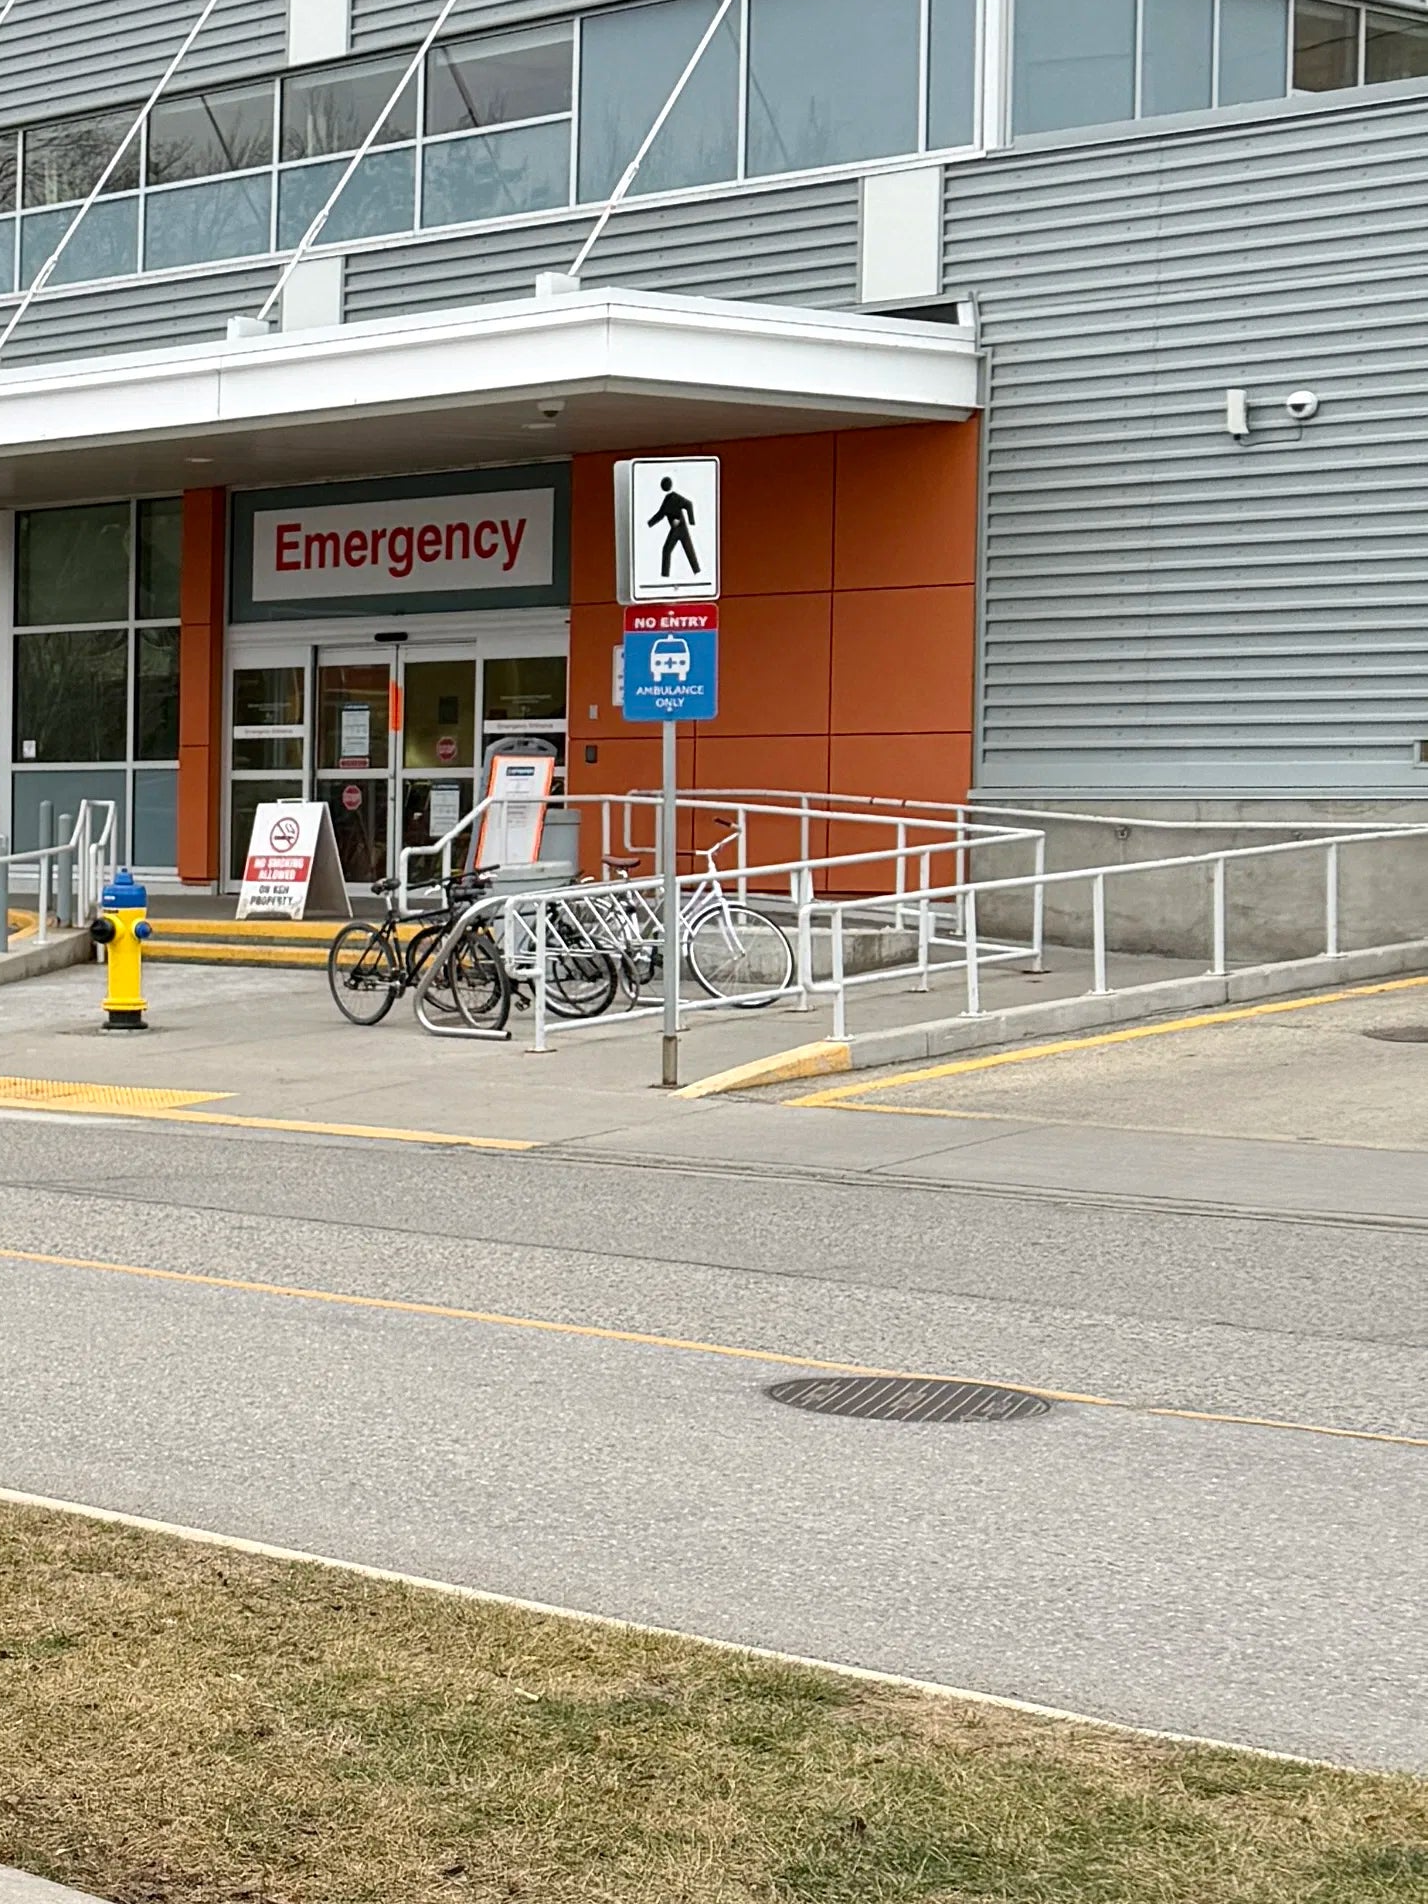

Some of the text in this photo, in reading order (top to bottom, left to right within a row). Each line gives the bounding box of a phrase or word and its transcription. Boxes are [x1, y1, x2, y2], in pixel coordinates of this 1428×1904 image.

[274, 517, 528, 578] Emergency
[634, 616, 708, 628] NO ENTRY
[636, 685, 704, 696] AMBULANCE
[655, 698, 685, 708] ONLY
[254, 858, 304, 869] NO SMOKING
[258, 869, 296, 880] ALLOWED
[259, 885, 270, 894] ON
[250, 896, 293, 906] PROPERTY
